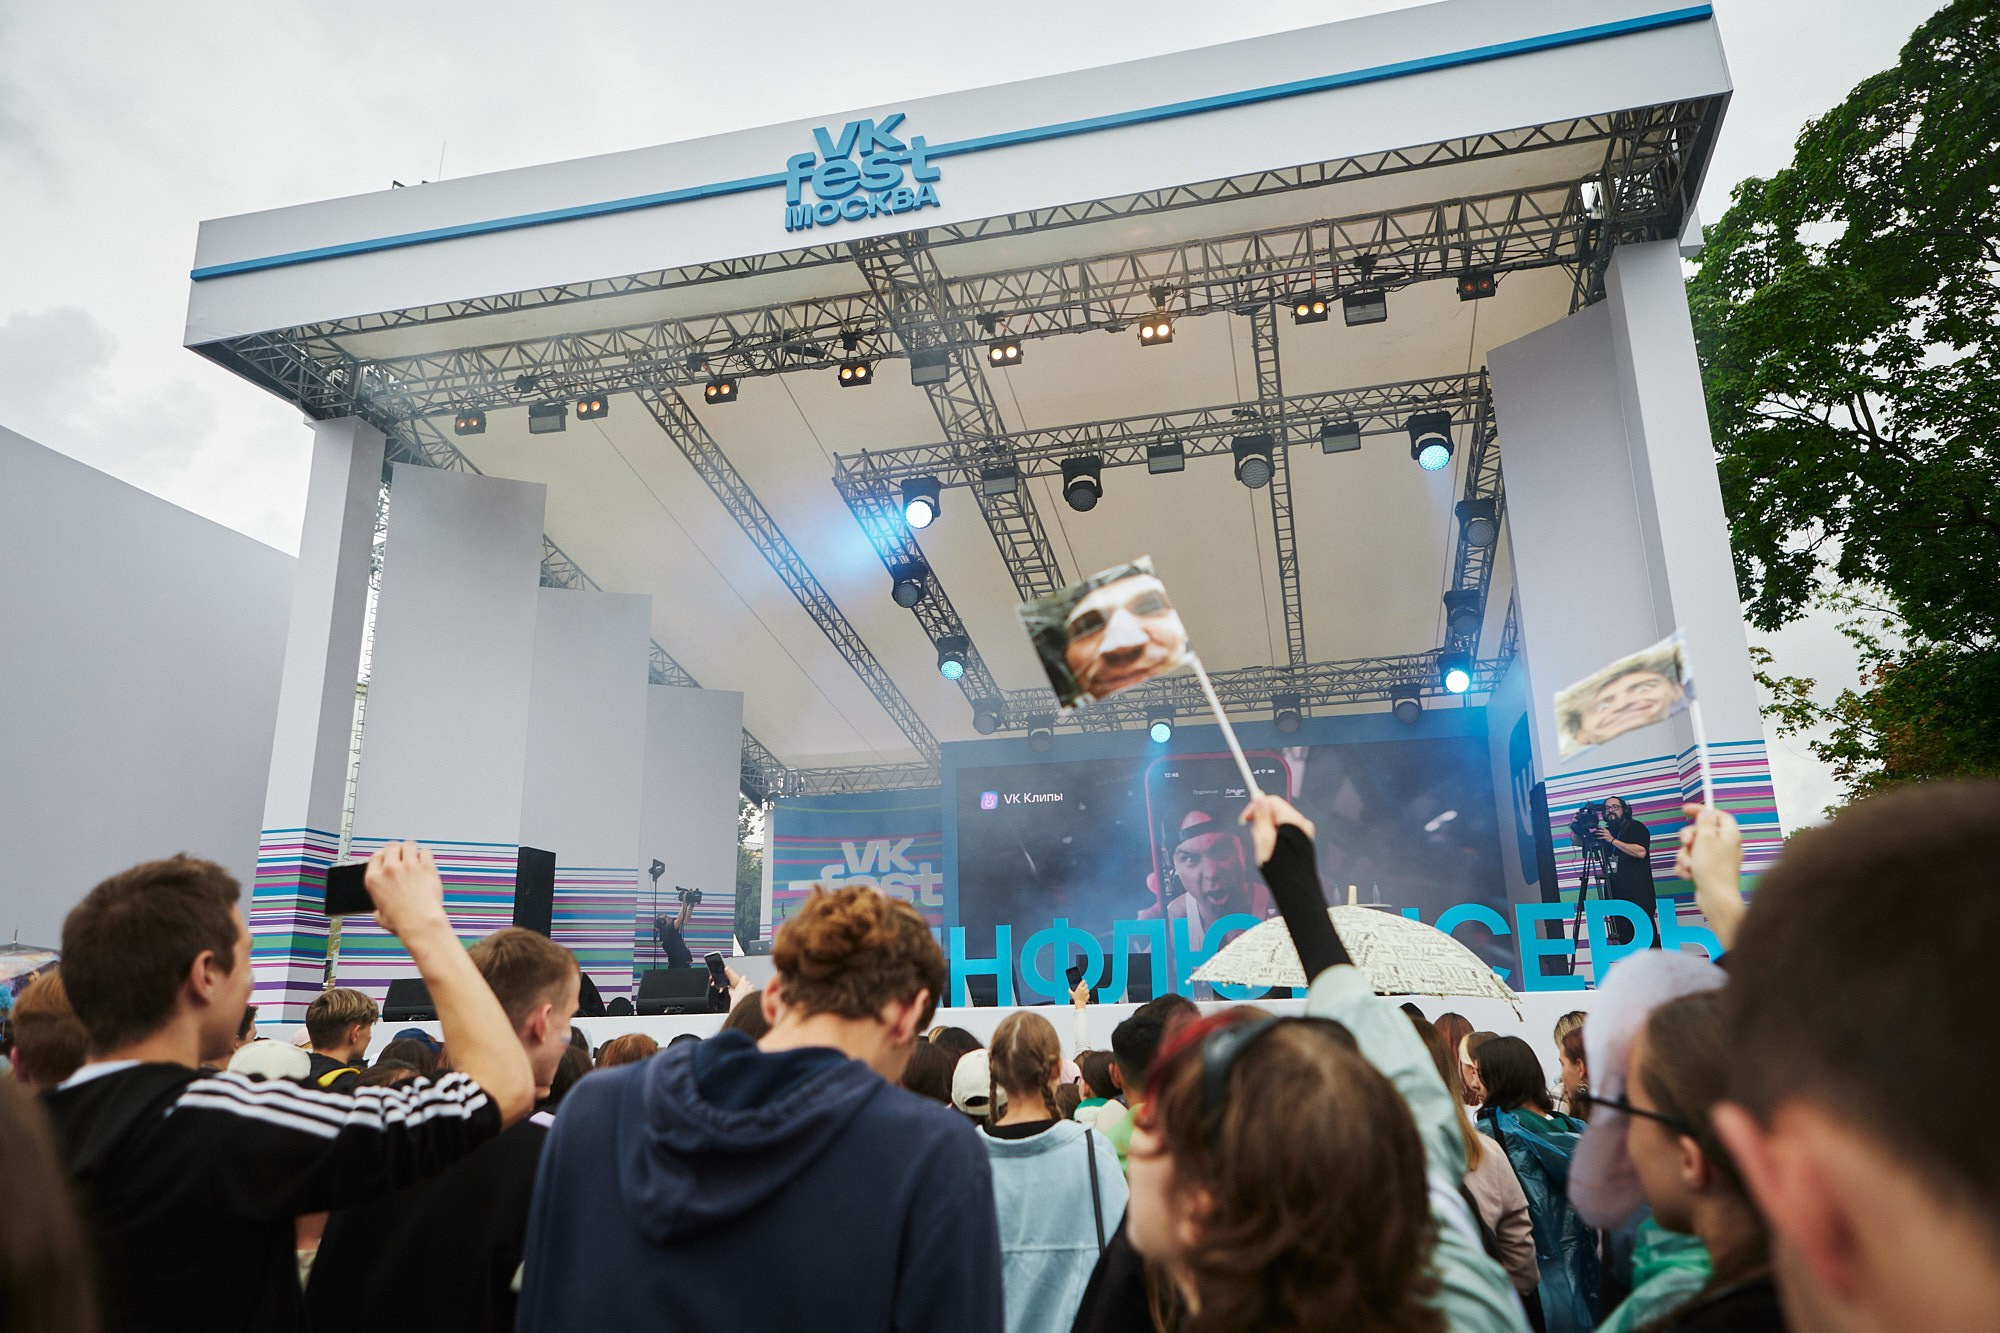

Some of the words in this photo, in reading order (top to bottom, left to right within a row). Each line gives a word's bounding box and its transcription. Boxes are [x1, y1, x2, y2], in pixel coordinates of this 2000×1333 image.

[812, 112, 907, 162] VK
[785, 135, 942, 207] fest
[785, 183, 941, 232] МОСКВА
[1004, 793, 1021, 805] VK
[1023, 792, 1063, 803] Клипы
[841, 837, 916, 874] VK
